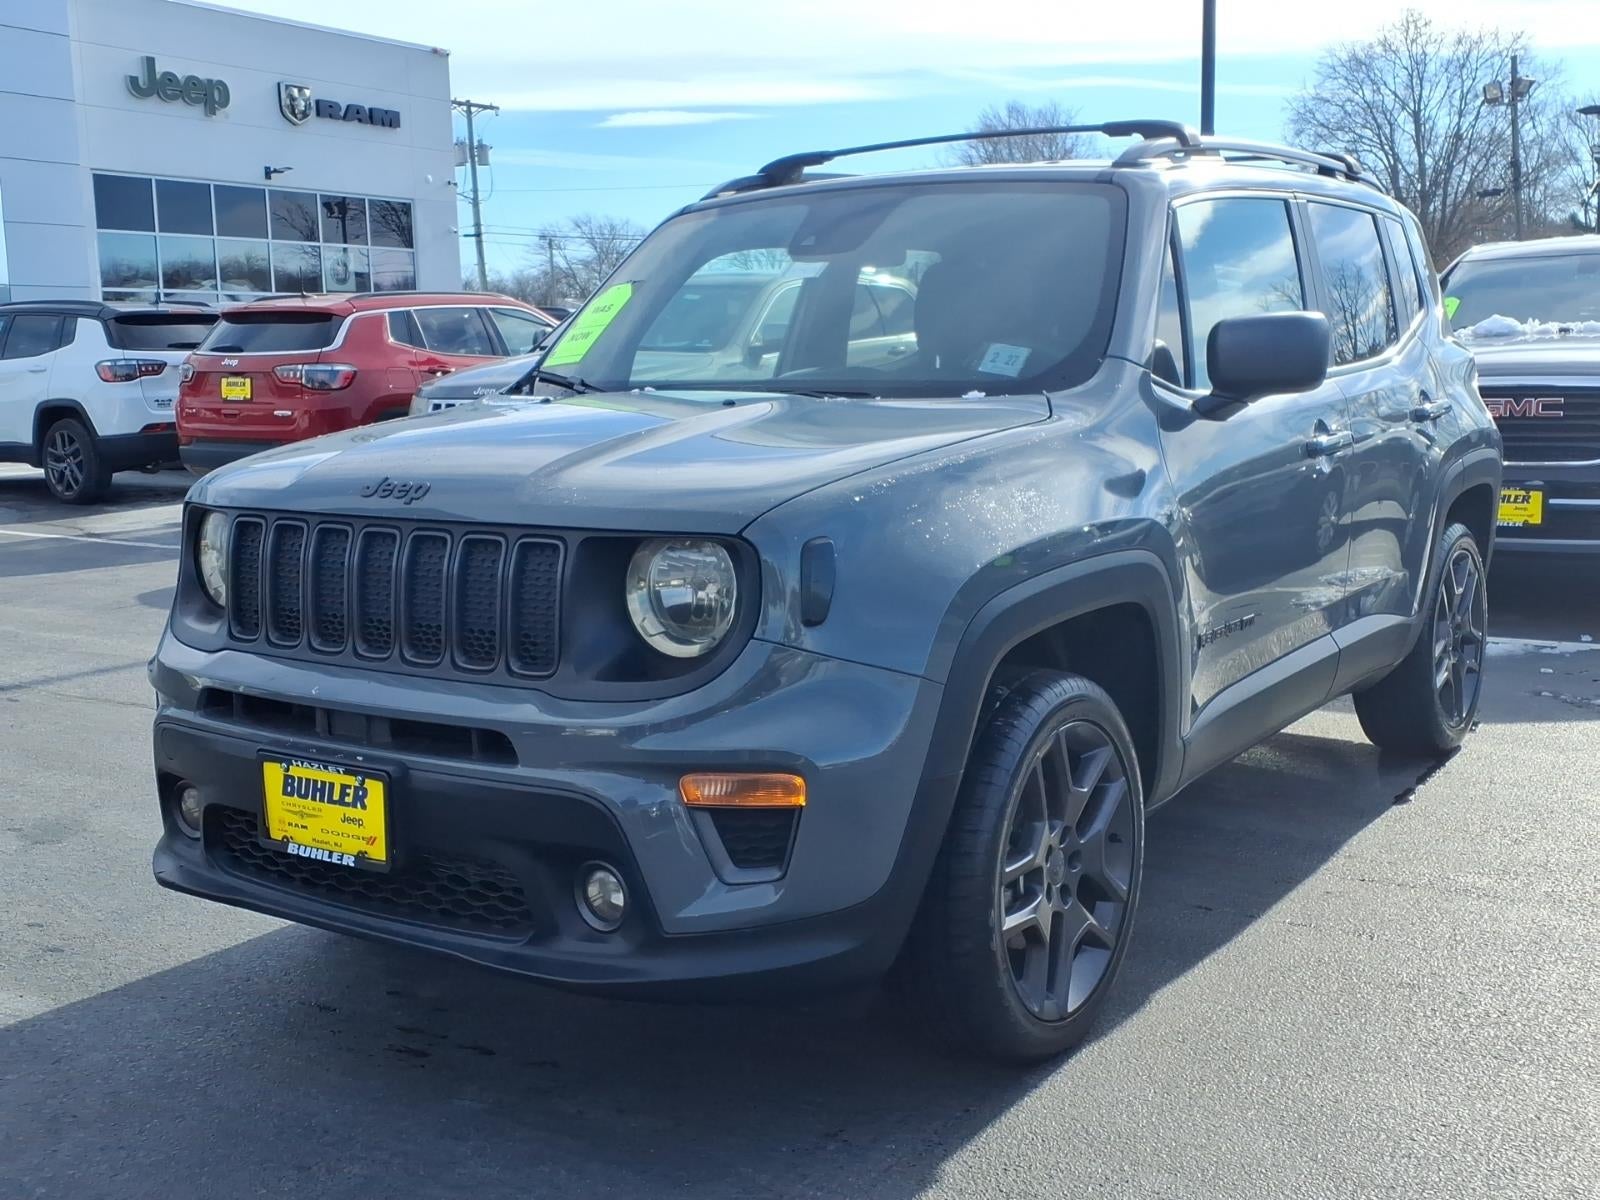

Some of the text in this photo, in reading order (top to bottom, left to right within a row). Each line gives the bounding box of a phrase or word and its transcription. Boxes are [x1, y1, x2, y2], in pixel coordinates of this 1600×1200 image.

[126, 55, 231, 117] Jeep
[315, 98, 401, 128] RAM
[221, 358, 239, 367] Jeep
[1482, 397, 1565, 417] GMC
[360, 476, 431, 505] Jeep
[1501, 494, 1531, 505] HLER
[291, 759, 346, 775] HAZLET
[281, 774, 369, 811] BUHLER
[280, 800, 323, 813] CHRYSLER
[287, 821, 309, 831] RAM
[340, 813, 364, 829] Jeep
[320, 827, 371, 842] DODGE
[287, 842, 356, 867] BUHLER
